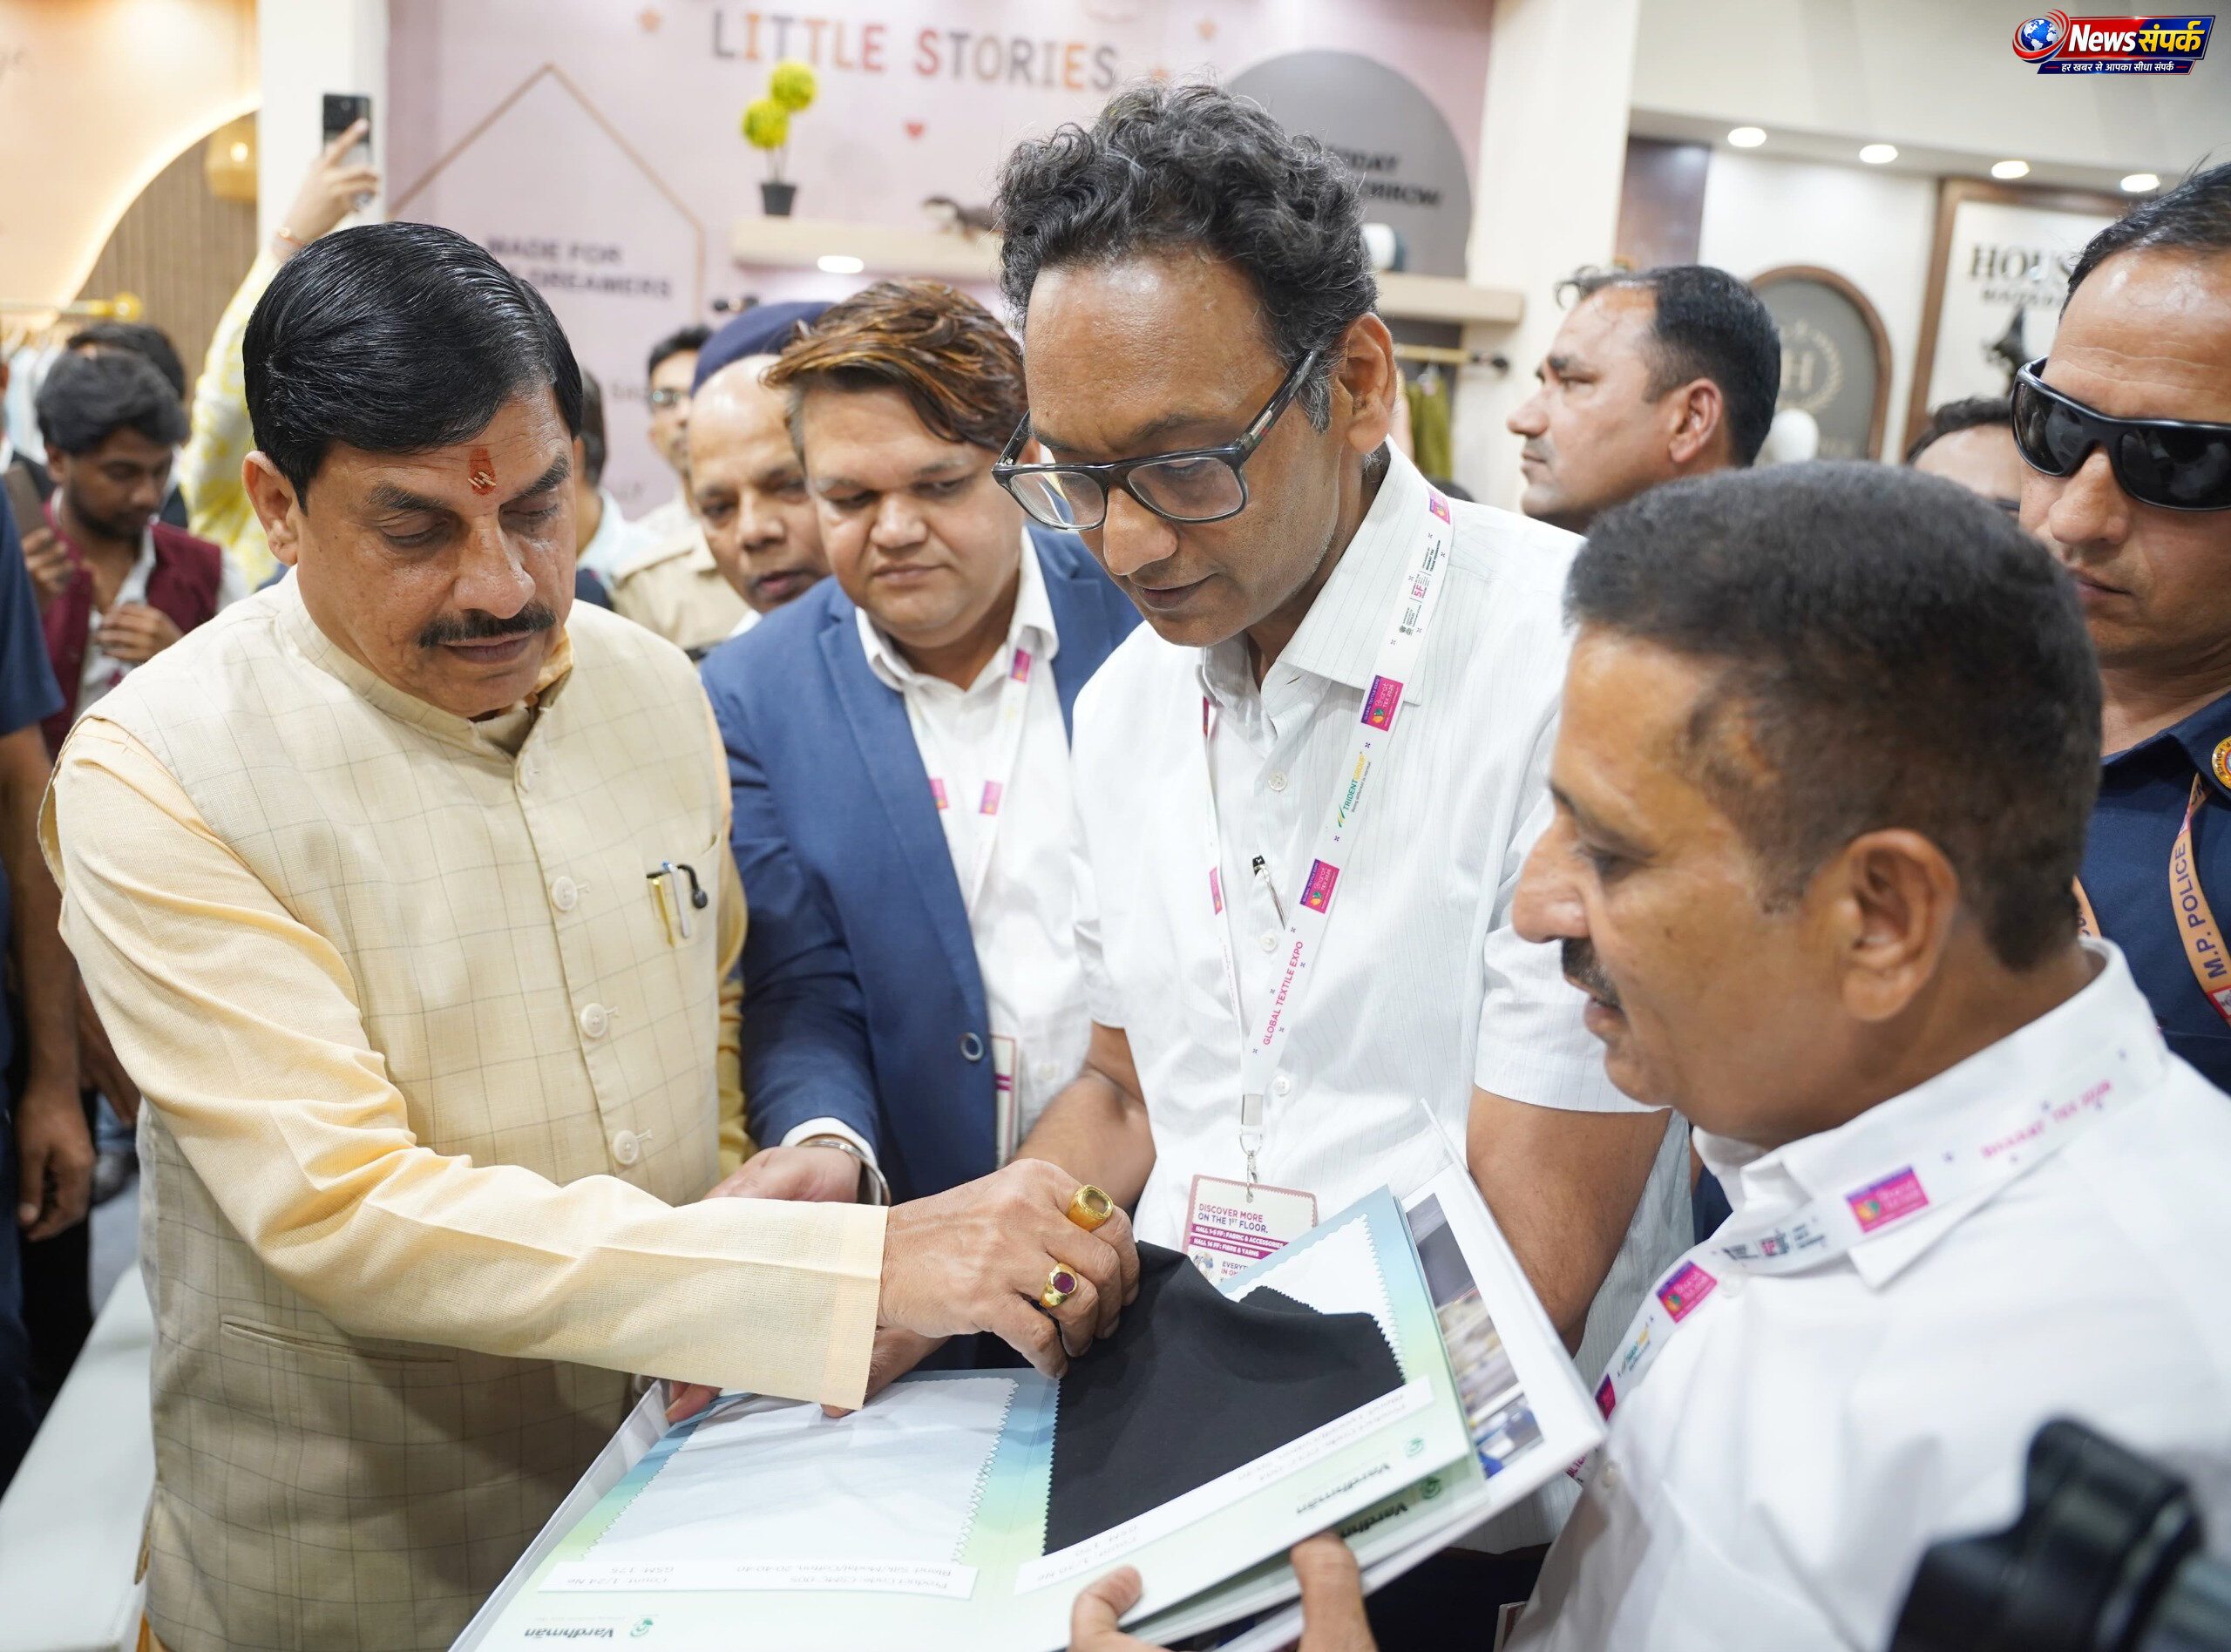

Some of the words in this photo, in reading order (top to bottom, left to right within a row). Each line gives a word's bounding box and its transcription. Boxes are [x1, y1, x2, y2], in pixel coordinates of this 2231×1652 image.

[712, 11, 888, 73] LITTLE
[915, 30, 1120, 91] STORIES
[487, 238, 559, 258] MADE
[570, 242, 622, 263] FOR
[1970, 245, 2073, 283] HOUS
[1414, 584, 1424, 597] 5F
[2173, 842, 2207, 929] POLICE
[2196, 931, 2228, 978] M.P.
[1263, 1009, 1282, 1046] GLOBAL
[1275, 967, 1295, 1006] TEXTILE
[1289, 941, 1304, 967] EXPO
[1197, 1212, 1210, 1222] ON
[1211, 1215, 1226, 1224] THE
[1238, 1220, 1269, 1234] FLOOR.
[1198, 1203, 1238, 1217] DISCOVER
[1240, 1210, 1264, 1222] MORE
[1195, 1225, 1210, 1234] HALL
[1193, 1237, 1207, 1246] HALL
[1222, 1261, 1249, 1271] EVERYT
